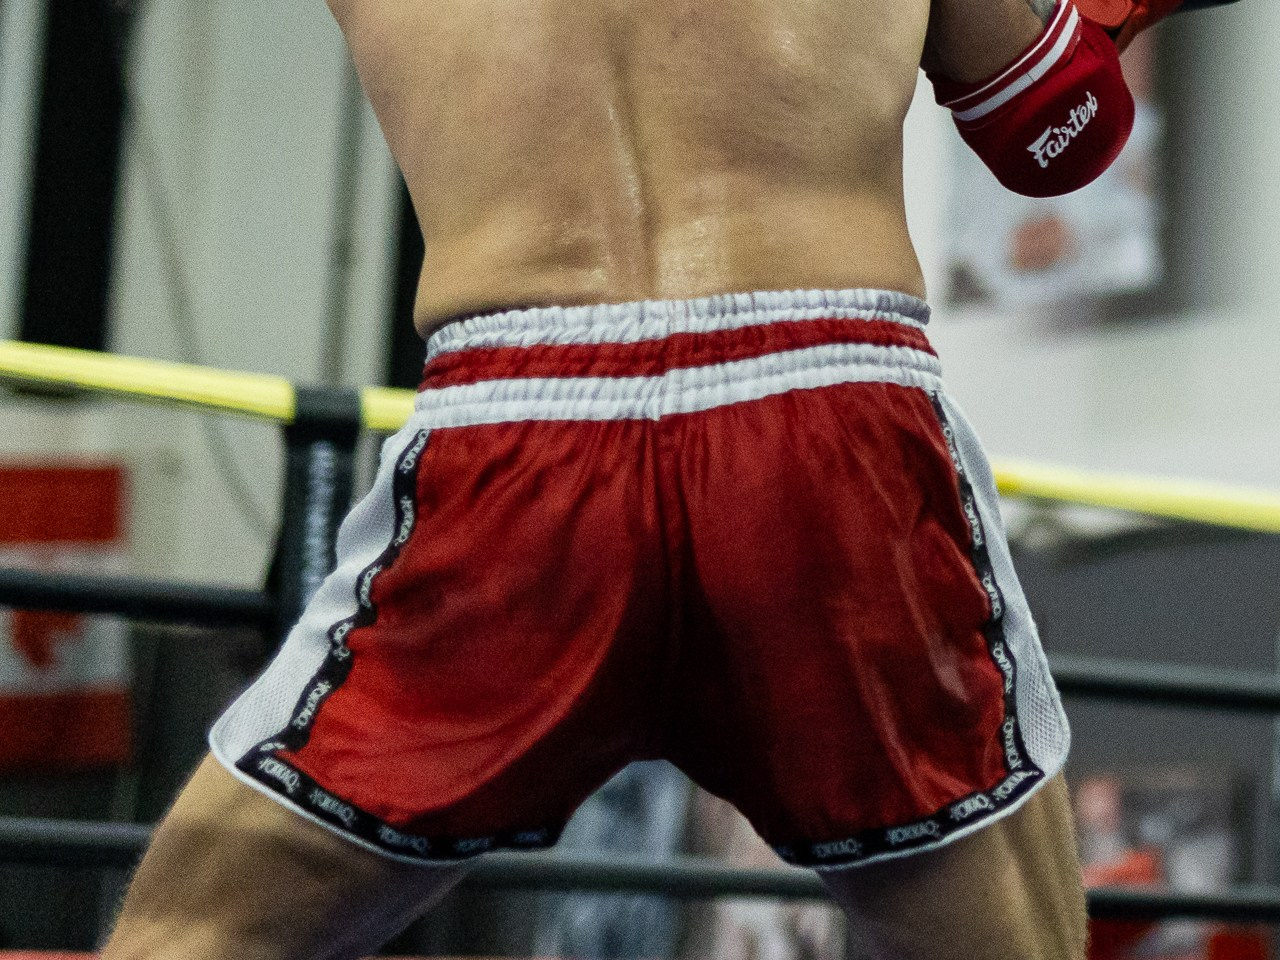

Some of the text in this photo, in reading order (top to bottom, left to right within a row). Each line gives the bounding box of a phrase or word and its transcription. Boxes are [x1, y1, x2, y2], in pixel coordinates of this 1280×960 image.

[1026, 91, 1098, 168] Fairtex
[291, 681, 332, 730] YOKKAO
[1003, 721, 1022, 770] YOKKAO
